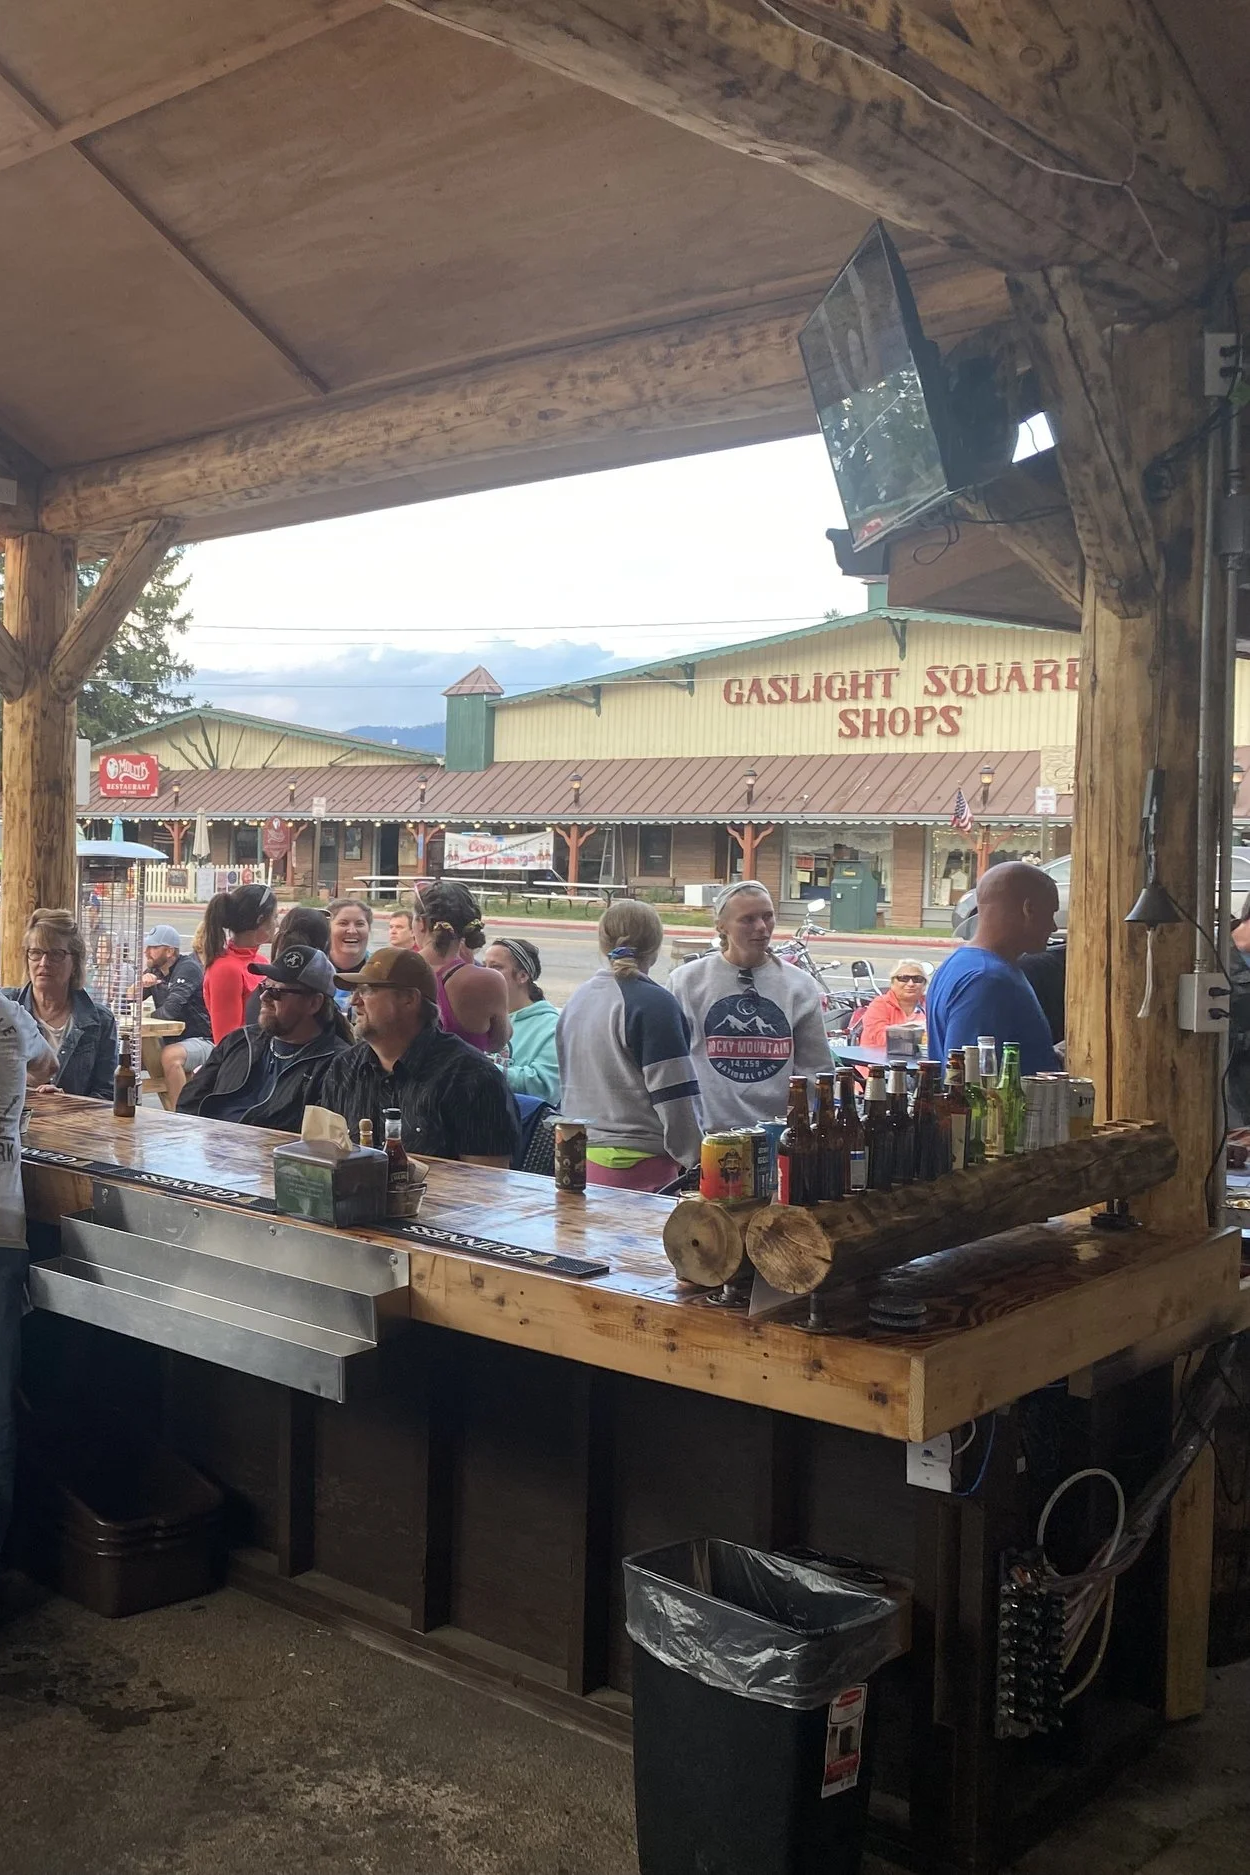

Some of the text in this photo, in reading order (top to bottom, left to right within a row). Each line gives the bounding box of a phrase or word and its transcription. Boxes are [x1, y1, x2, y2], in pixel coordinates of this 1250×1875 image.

[722, 667, 901, 706] GASLIGHT
[837, 705, 964, 740] SHOPS
[106, 783, 151, 791] RESTAURANT
[707, 1040, 790, 1054] ROCKY MOUNTAIN
[716, 1061, 778, 1080] NATIONAL PARK
[135, 1173, 240, 1200] GUINNESS
[402, 1225, 534, 1258] GUINNESS
